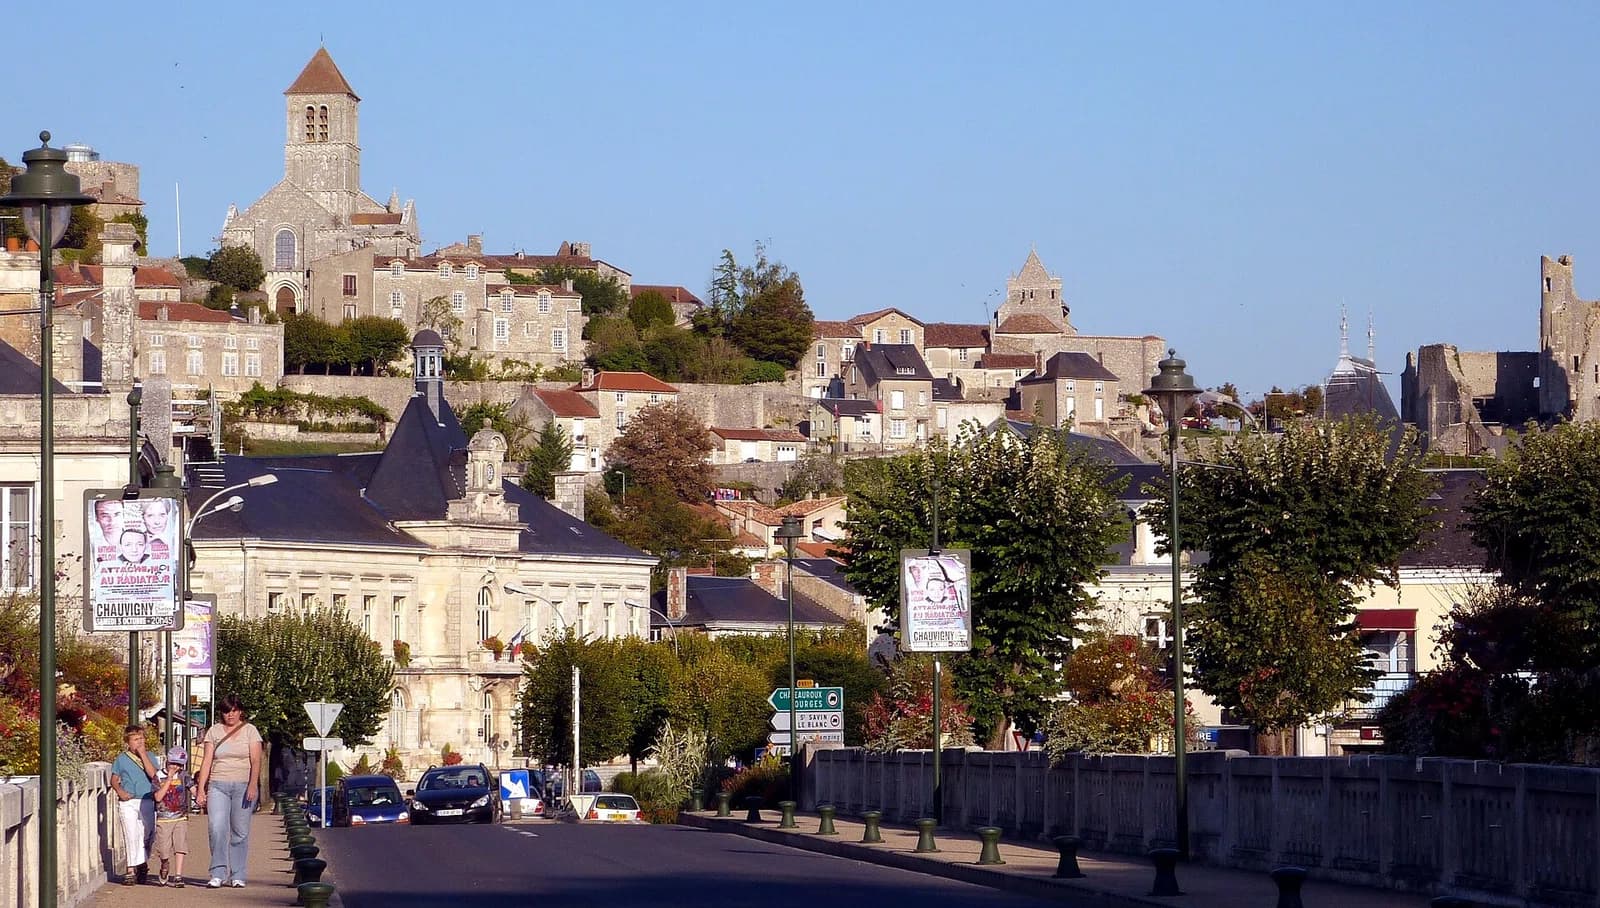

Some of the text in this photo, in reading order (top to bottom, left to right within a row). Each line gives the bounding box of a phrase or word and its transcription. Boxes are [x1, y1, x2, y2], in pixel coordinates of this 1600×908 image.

[100, 576, 114, 585] AU
[97, 603, 154, 616] CHAUVIGNY
[913, 631, 955, 641] CHAUVIGNY
[779, 691, 823, 699] CHAEAUROUX
